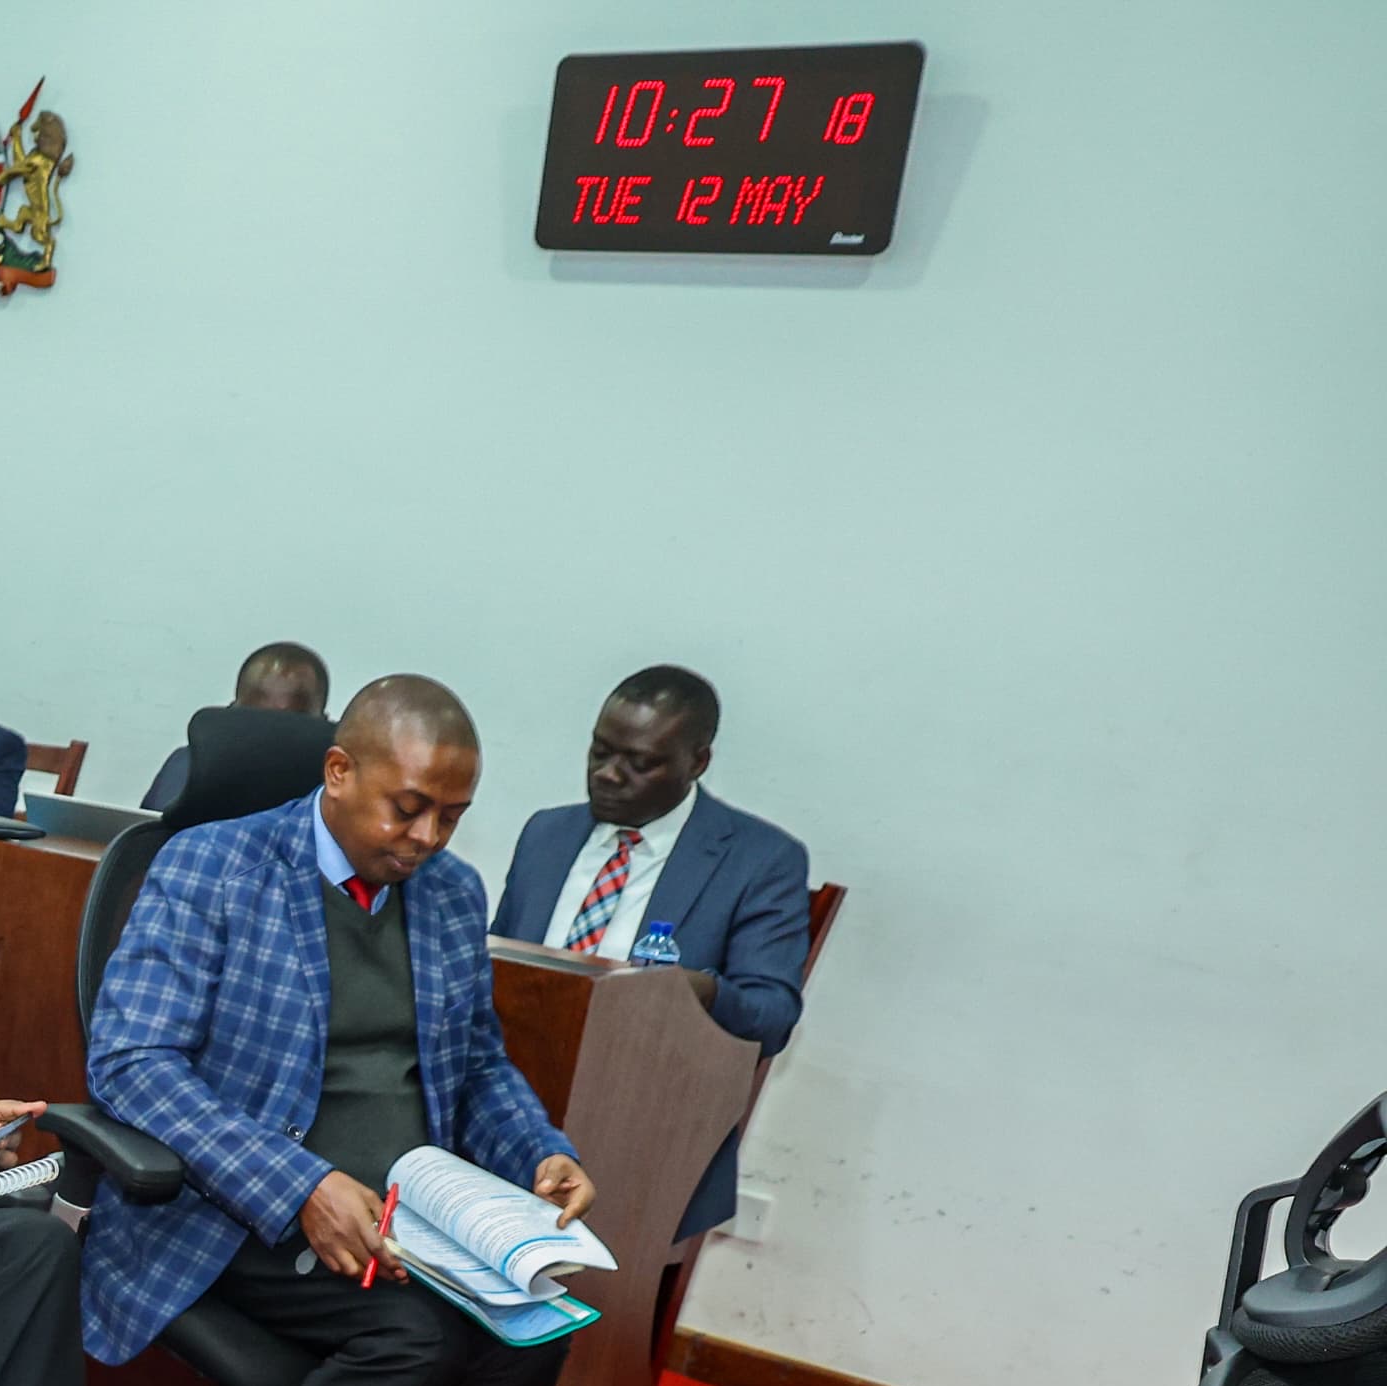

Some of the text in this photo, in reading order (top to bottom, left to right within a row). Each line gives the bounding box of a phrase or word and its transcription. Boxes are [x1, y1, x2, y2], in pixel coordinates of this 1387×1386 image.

[595, 76, 875, 148] 10:27 18
[572, 175, 825, 225] TUE 12 MAY
